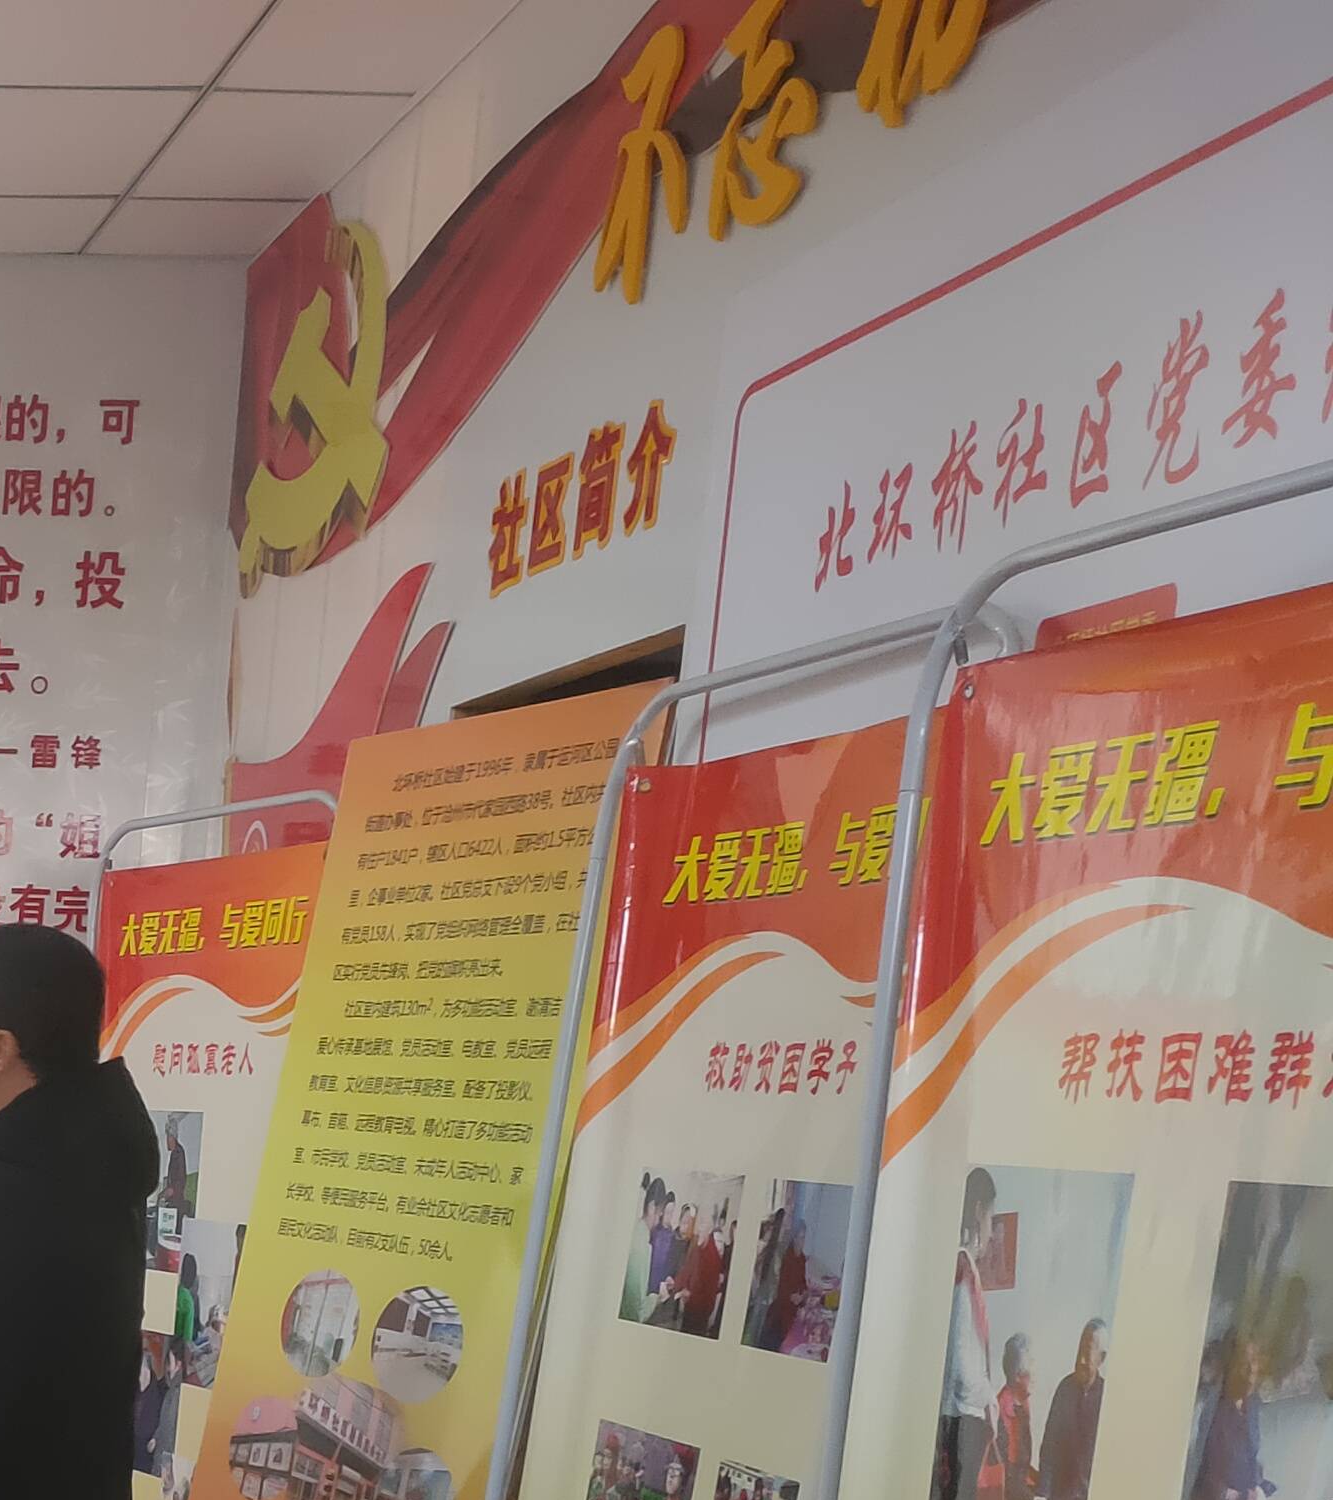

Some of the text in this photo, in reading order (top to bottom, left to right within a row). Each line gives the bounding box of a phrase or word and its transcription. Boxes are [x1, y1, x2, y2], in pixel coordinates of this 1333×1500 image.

[814, 288, 1333, 592] 北环桥社区党委
[488, 398, 675, 600] 社区简介
[118, 894, 310, 957] 大爱无疆，与爱同行
[152, 1042, 255, 1078] 慰问孤寡老人
[704, 1039, 858, 1096] 救助贫困学子
[1057, 1028, 1333, 1110] 帮扶困难群
